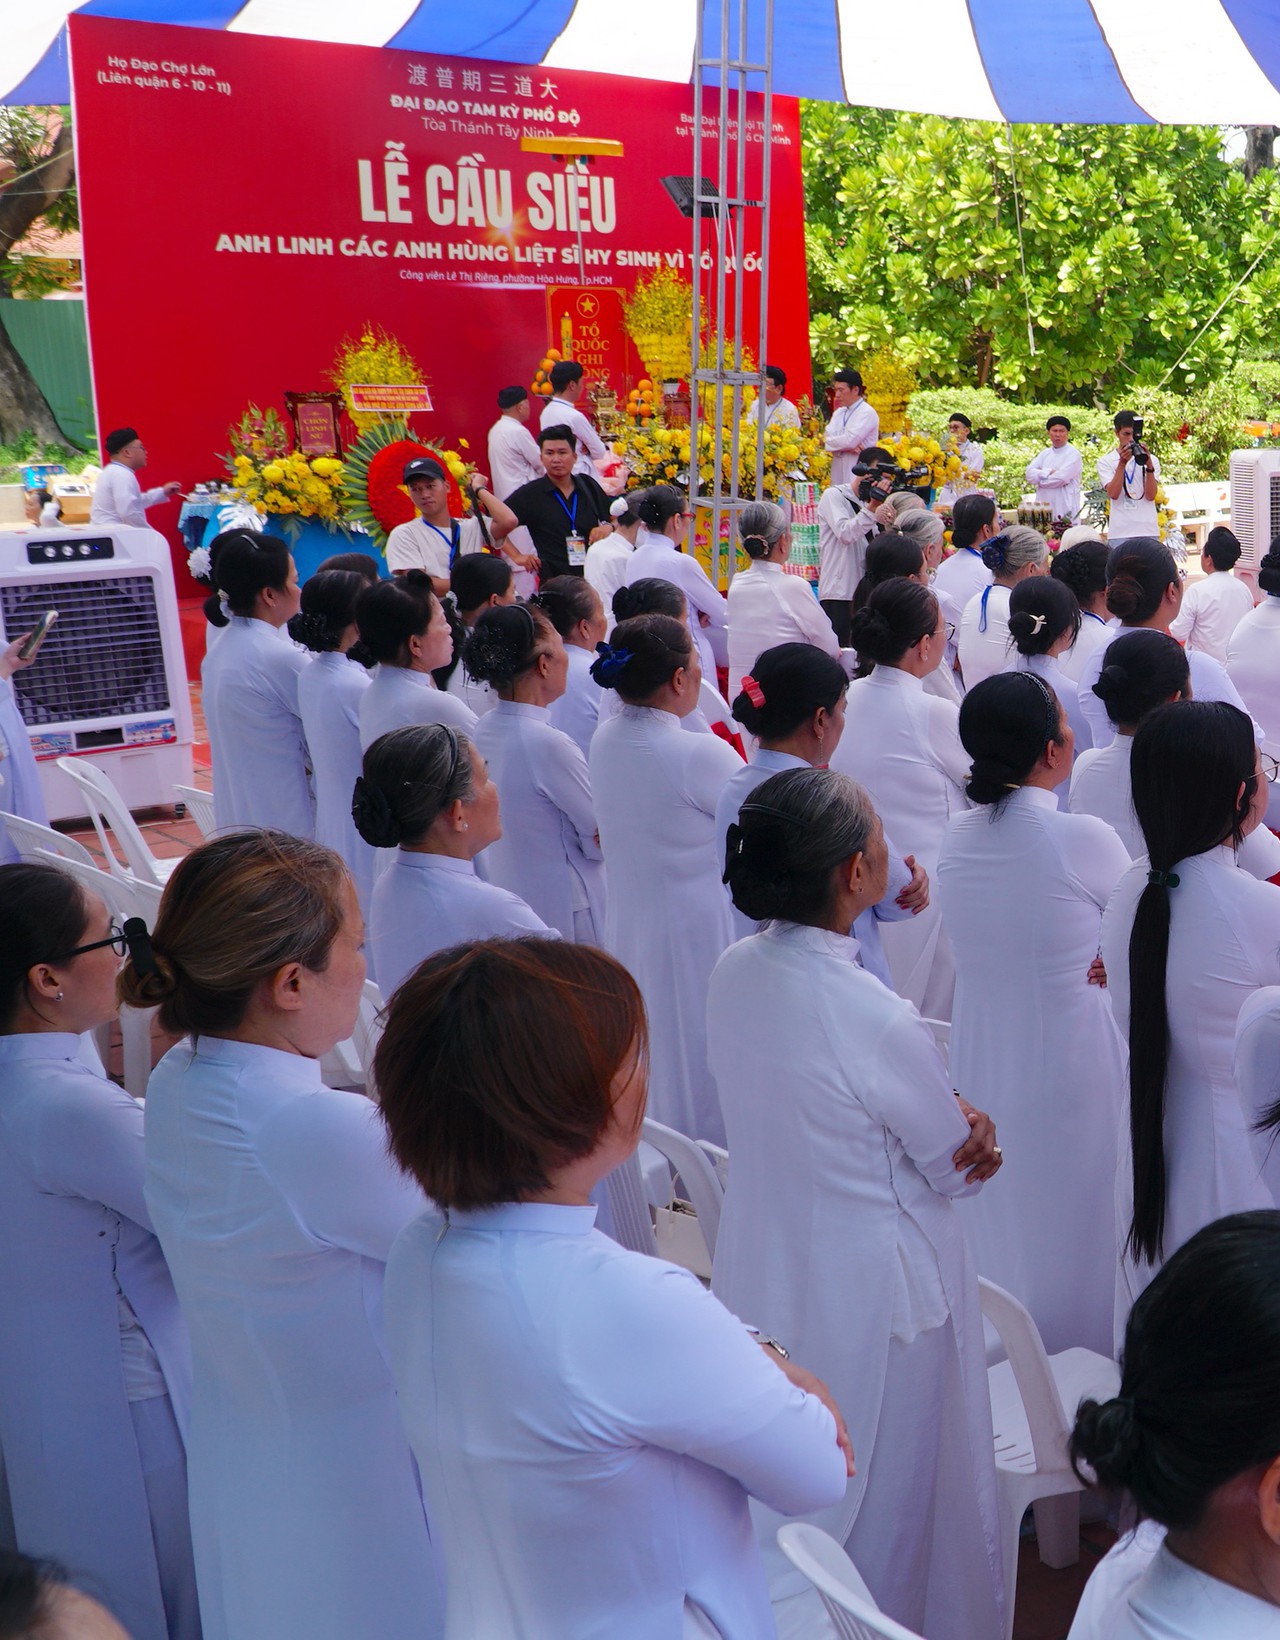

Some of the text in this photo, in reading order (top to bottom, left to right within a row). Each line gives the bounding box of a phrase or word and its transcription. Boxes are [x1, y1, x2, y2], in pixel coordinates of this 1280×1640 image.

[108, 56, 216, 77] Họ Đạo Chợ Lớn
[97, 70, 132, 85] (Liên
[134, 75, 169, 90] quận
[172, 78, 182, 89] 6
[192, 80, 206, 92] 10
[216, 82, 232, 96] 11)
[390, 94, 420, 112] ĐẠI
[424, 97, 460, 116] ĐẠO
[462, 102, 496, 117] TAM
[500, 103, 520, 119] KỲ
[558, 109, 581, 128] ĐỘ
[422, 116, 447, 132] Tòa
[450, 119, 494, 136] Thánh
[497, 124, 520, 140] Tây
[358, 140, 413, 224] LỄ
[426, 152, 514, 229] CẦU
[216, 234, 271, 254] ANH
[277, 236, 334, 256] LINH
[339, 234, 388, 258] CÁC
[393, 240, 442, 260] ANH
[448, 239, 509, 262] HÙNG
[514, 242, 556, 268] LIỆT
[585, 249, 612, 266] HY
[616, 250, 661, 268] SINH
[664, 248, 684, 269] VÌ
[400, 270, 424, 282] Công
[426, 270, 444, 280] viên
[446, 271, 458, 281] Lê
[458, 272, 473, 282] Thị
[536, 274, 554, 284] Hòa
[578, 320, 600, 337] TỔ
[572, 336, 610, 353] QUỐC
[576, 354, 603, 364] GHI
[582, 366, 610, 379] ÔNG
